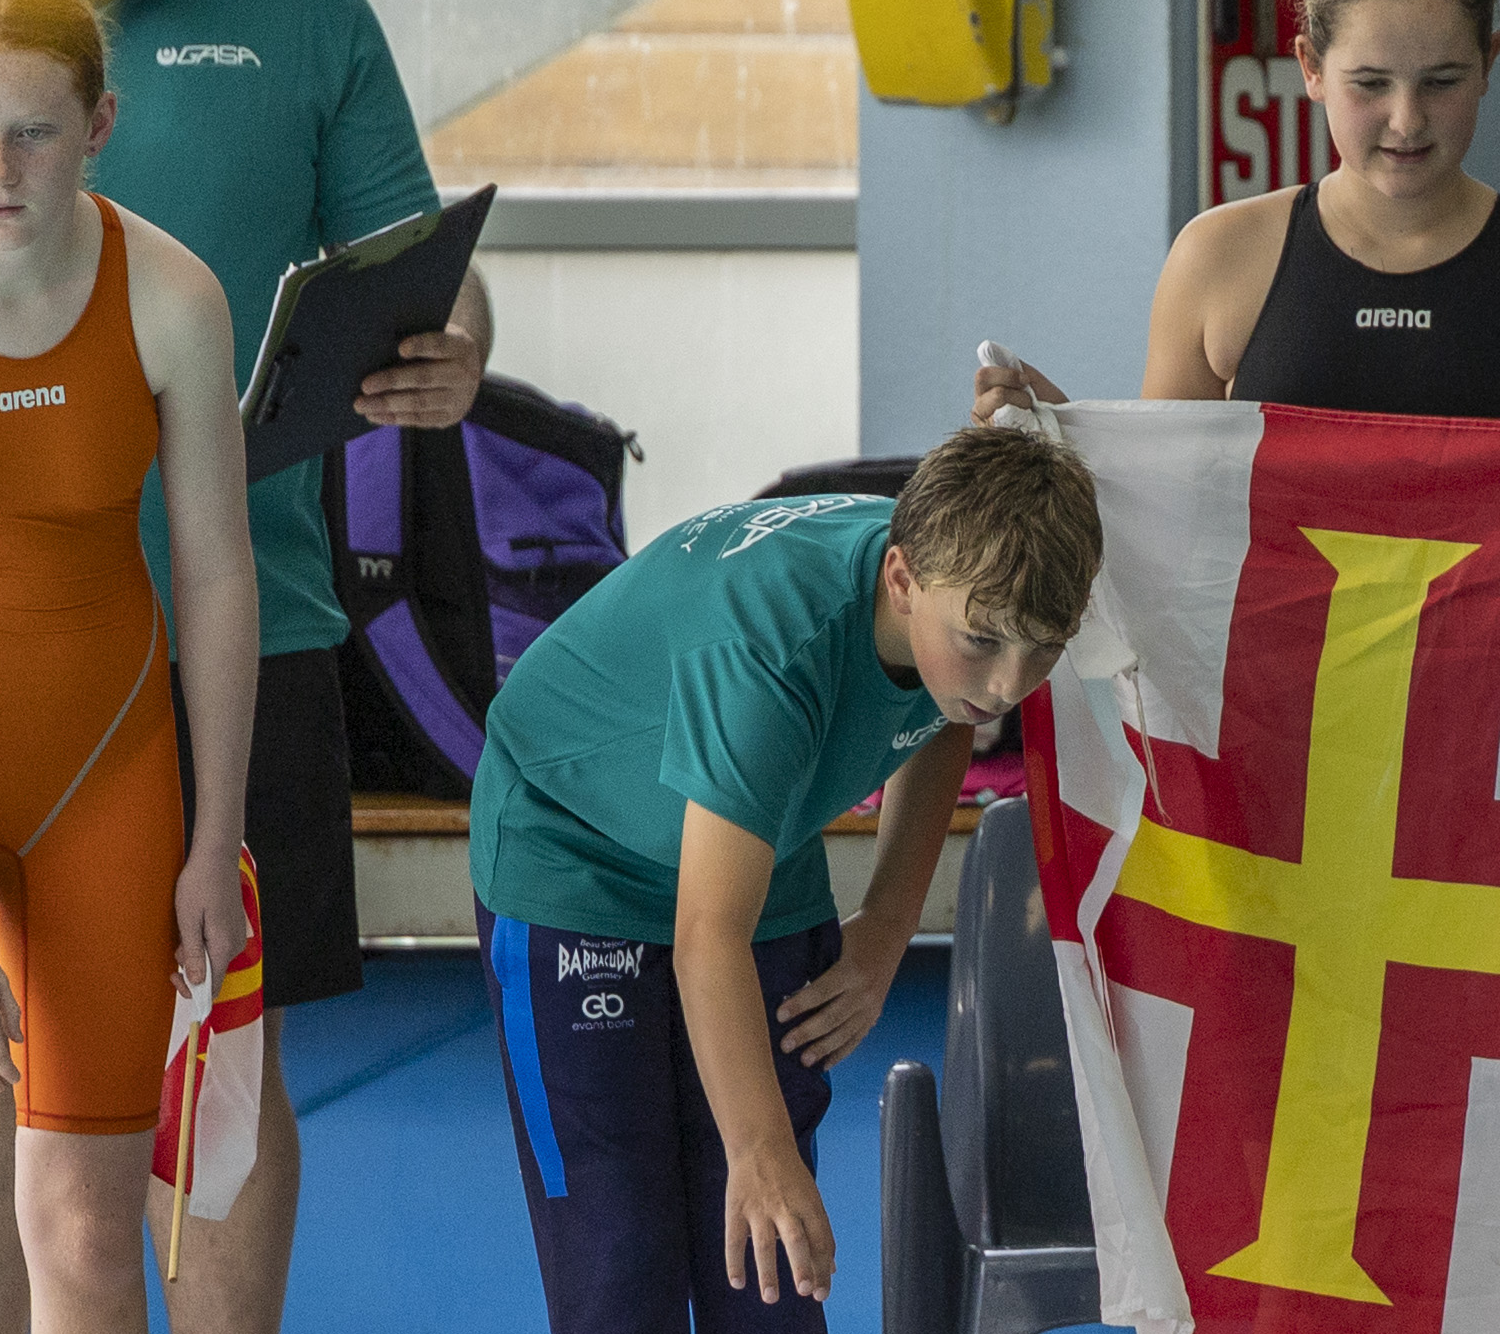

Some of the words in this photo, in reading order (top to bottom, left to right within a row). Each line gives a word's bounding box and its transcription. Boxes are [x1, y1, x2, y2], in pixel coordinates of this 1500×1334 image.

[176, 44, 262, 68] GASA
[1356, 307, 1431, 329] arena
[580, 938, 601, 948] Beau
[558, 942, 644, 983] BARRACUDAS
[582, 971, 623, 982] Guernsey
[571, 1021, 605, 1032] evans
[607, 1018, 635, 1030] bond
